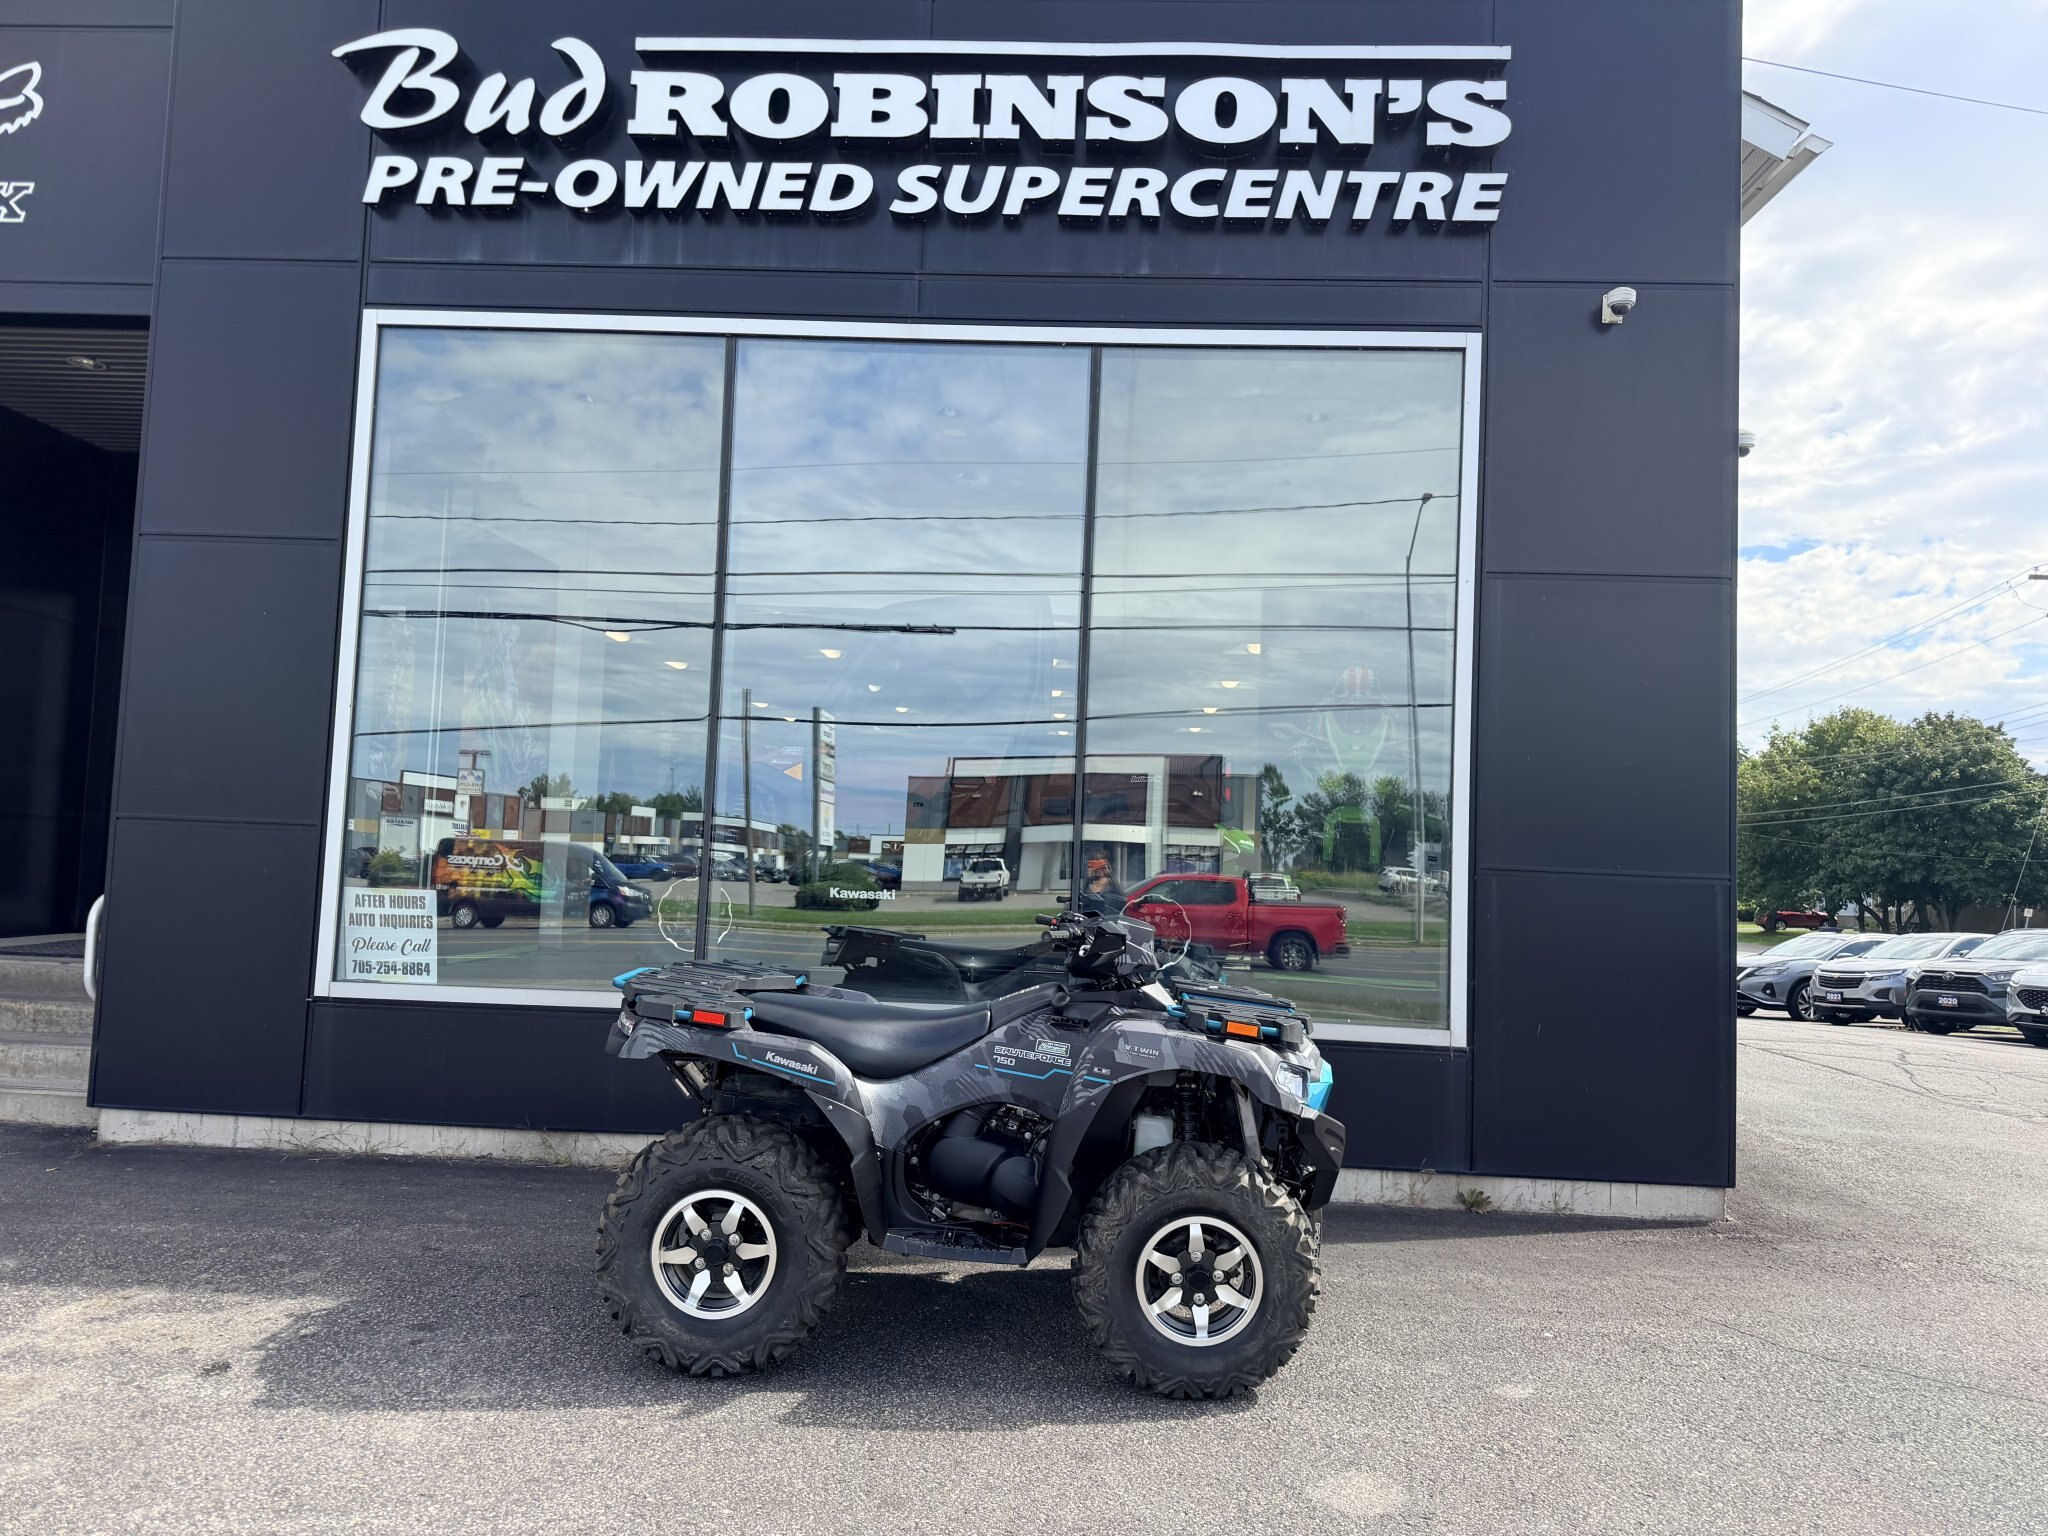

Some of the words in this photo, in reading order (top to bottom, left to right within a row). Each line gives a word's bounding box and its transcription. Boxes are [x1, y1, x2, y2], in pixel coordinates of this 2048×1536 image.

[331, 27, 607, 137] Bud
[626, 69, 1513, 149] ROBINSON'S
[361, 155, 875, 213] PRE-OWNED
[888, 159, 1509, 223] SUPERCENTRE
[354, 893, 386, 909] AFTER
[388, 894, 426, 910] HOURS
[829, 887, 897, 900] Kawasaki
[348, 912, 376, 928] AUTO
[378, 913, 434, 930] INQUIRIES
[351, 936, 398, 954] Please
[400, 938, 432, 956] Call
[351, 959, 431, 977] 705-254-8864
[1938, 996, 1958, 1005] 2020
[1125, 1043, 1160, 1056] V-TWIN
[765, 1050, 819, 1075] Kawasaki
[992, 1055, 1016, 1066] 750
